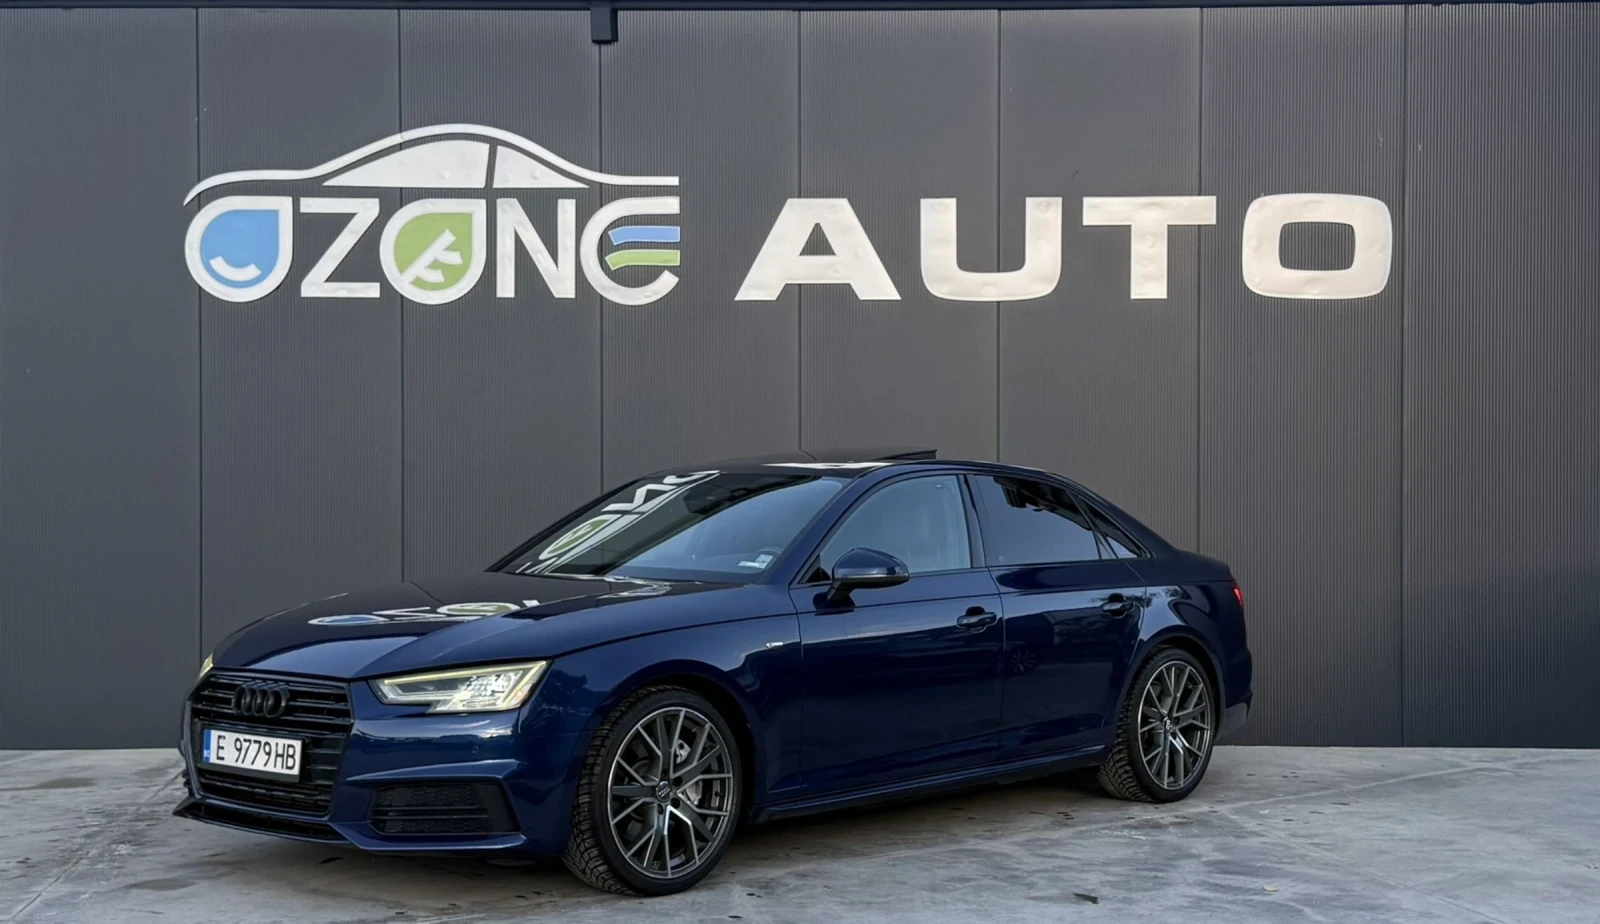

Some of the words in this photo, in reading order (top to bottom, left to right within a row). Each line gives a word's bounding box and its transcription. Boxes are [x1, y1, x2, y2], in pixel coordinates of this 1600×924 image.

[185, 196, 680, 305] OZONE
[734, 193, 1392, 301] AUTO
[216, 735, 226, 761] E
